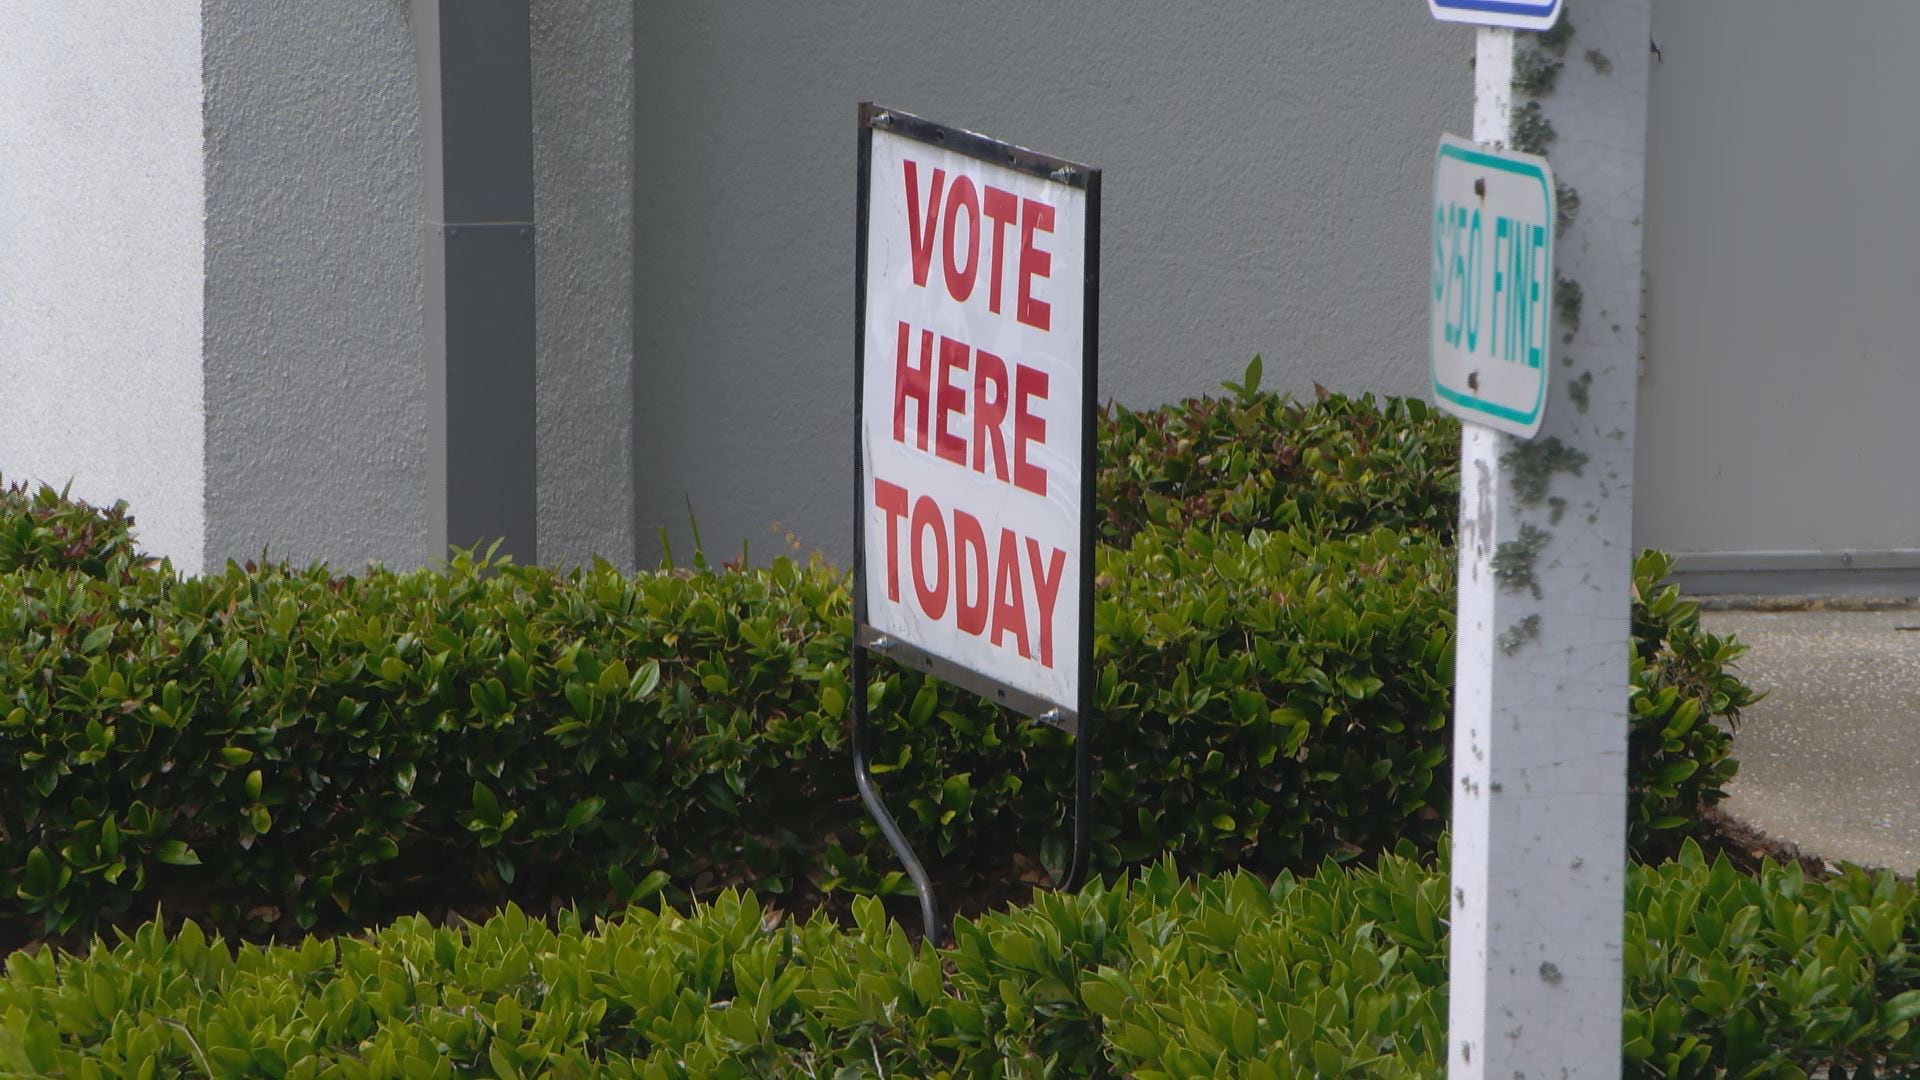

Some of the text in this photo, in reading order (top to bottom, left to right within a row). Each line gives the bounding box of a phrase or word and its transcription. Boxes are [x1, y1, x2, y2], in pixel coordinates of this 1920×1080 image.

[903, 160, 1055, 331] VOTE
[1434, 202, 1545, 369] $250 FINE
[893, 321, 1049, 497] HERE
[874, 479, 1066, 669] TODAY
